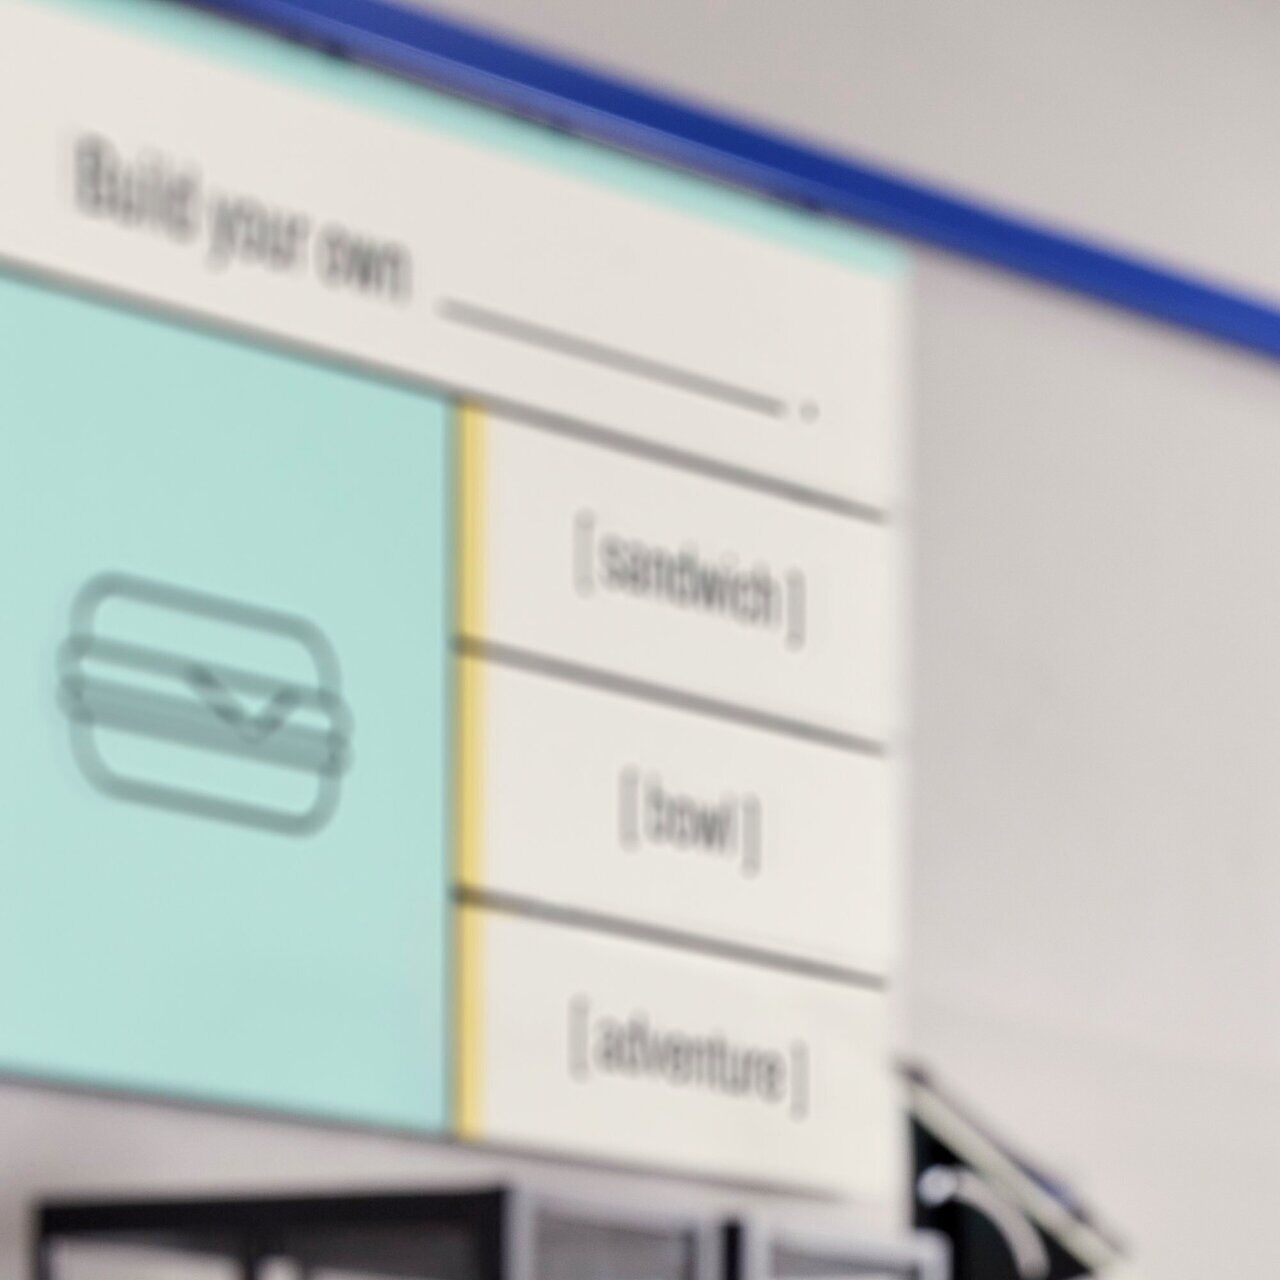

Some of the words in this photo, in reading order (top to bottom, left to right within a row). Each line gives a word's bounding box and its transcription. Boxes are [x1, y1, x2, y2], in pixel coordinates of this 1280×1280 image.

[73, 131, 200, 243] Build
[204, 188, 308, 274] your
[314, 224, 414, 304] own
